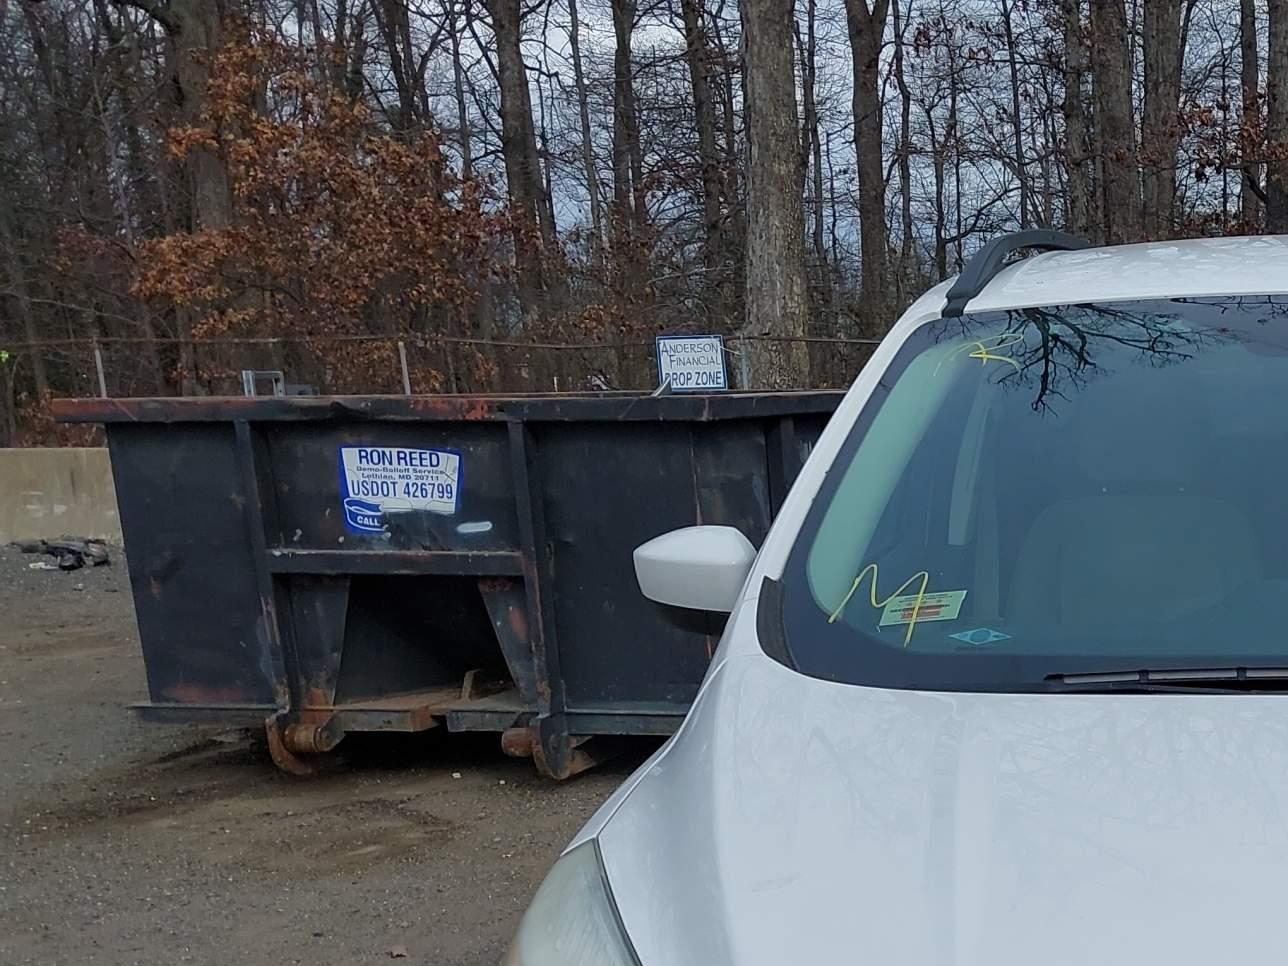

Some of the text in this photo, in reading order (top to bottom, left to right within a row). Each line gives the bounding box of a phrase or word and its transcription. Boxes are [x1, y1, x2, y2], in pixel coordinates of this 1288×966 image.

[661, 342, 719, 356] ANDERSON
[669, 354, 721, 368] FINANCIAL
[695, 370, 722, 386] ZONE
[358, 449, 440, 468] RON REED
[351, 480, 453, 499] USDOT 426799
[357, 515, 381, 526] CALL
